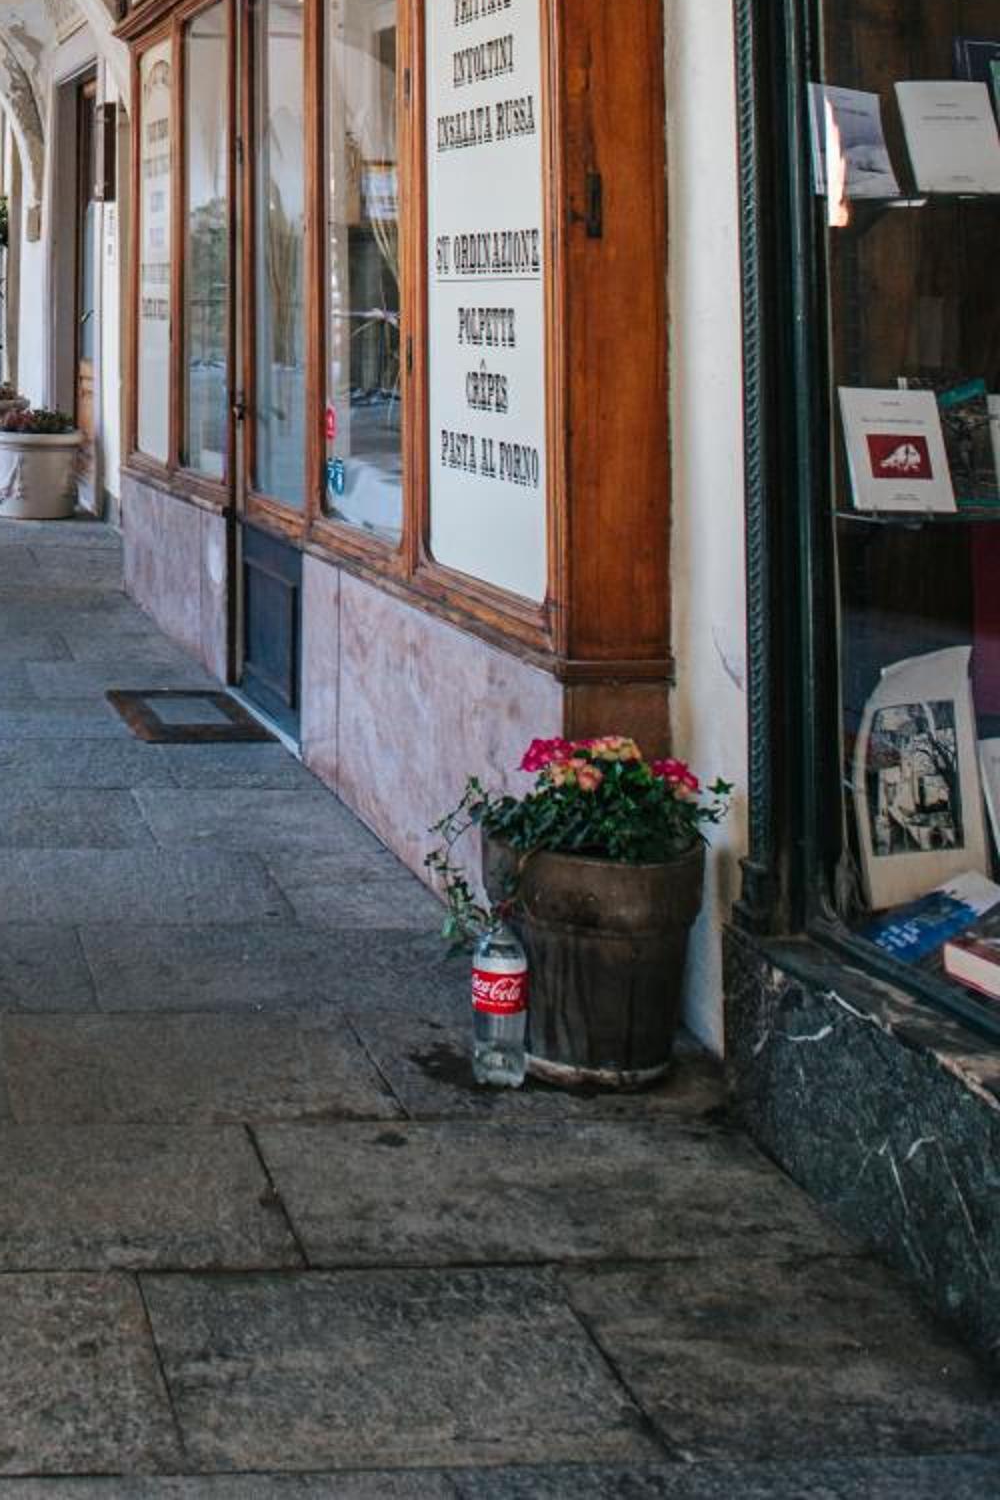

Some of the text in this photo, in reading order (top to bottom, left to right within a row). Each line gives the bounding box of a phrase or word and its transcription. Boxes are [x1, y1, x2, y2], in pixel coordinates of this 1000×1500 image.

[453, 34, 514, 88] INVOLTINI
[437, 95, 535, 152] INSALATA RUSSA
[453, 228, 540, 274] ORDINAZIONE
[457, 307, 516, 347] POLPETTE
[440, 429, 477, 474] PASTA
[479, 438, 497, 479] AL
